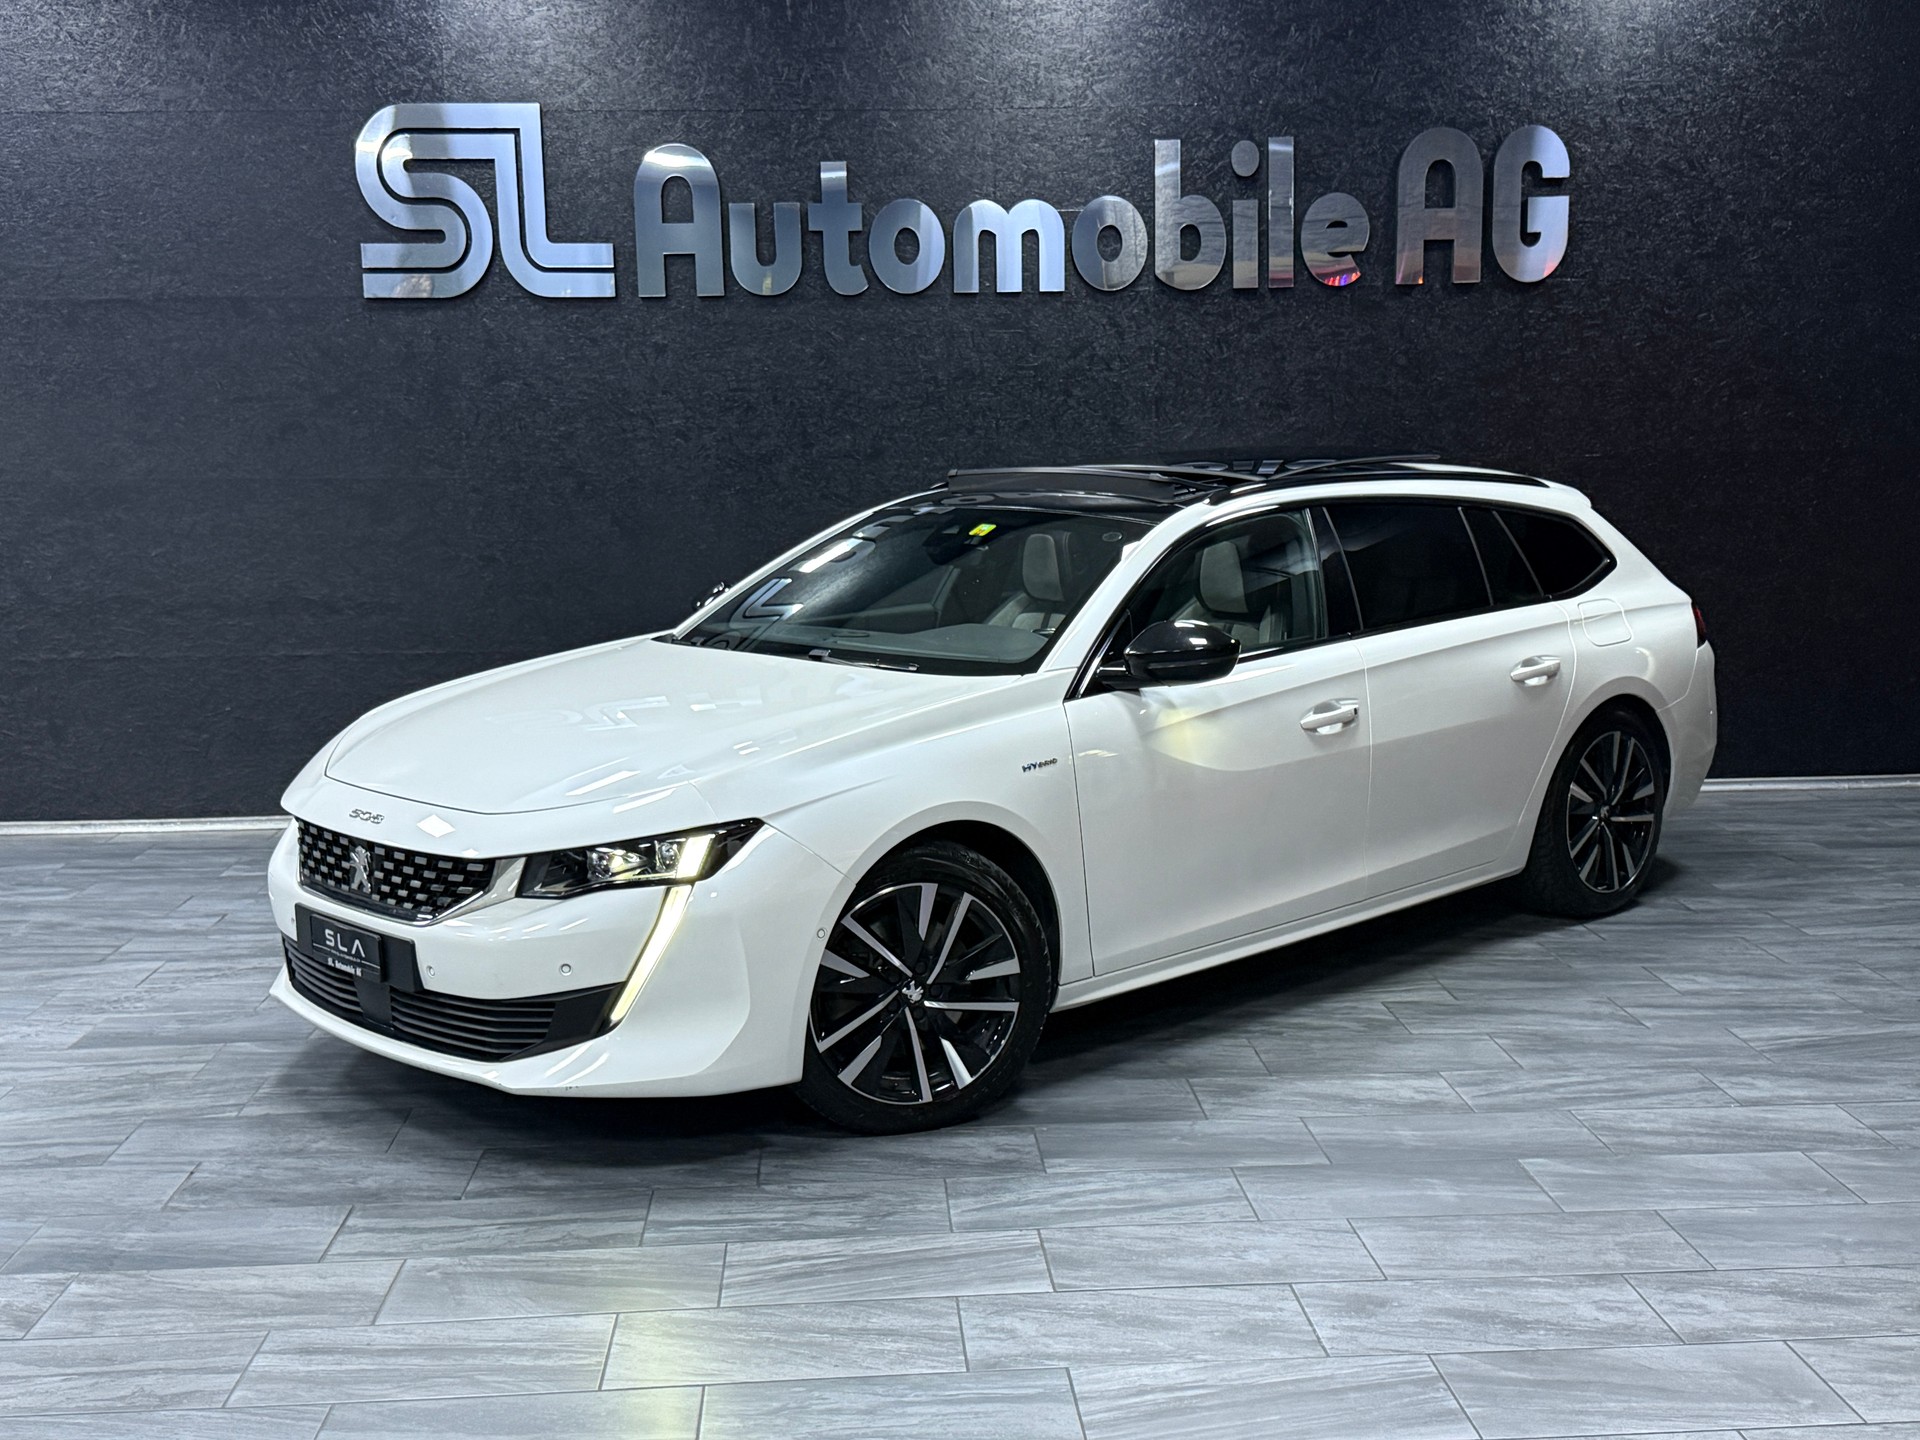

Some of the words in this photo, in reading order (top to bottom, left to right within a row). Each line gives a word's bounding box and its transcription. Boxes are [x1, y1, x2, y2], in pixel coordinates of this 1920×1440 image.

[354, 102, 616, 299] SL
[633, 135, 1371, 298] Automobile
[1396, 124, 1571, 286] AG
[324, 928, 366, 958] SLA
